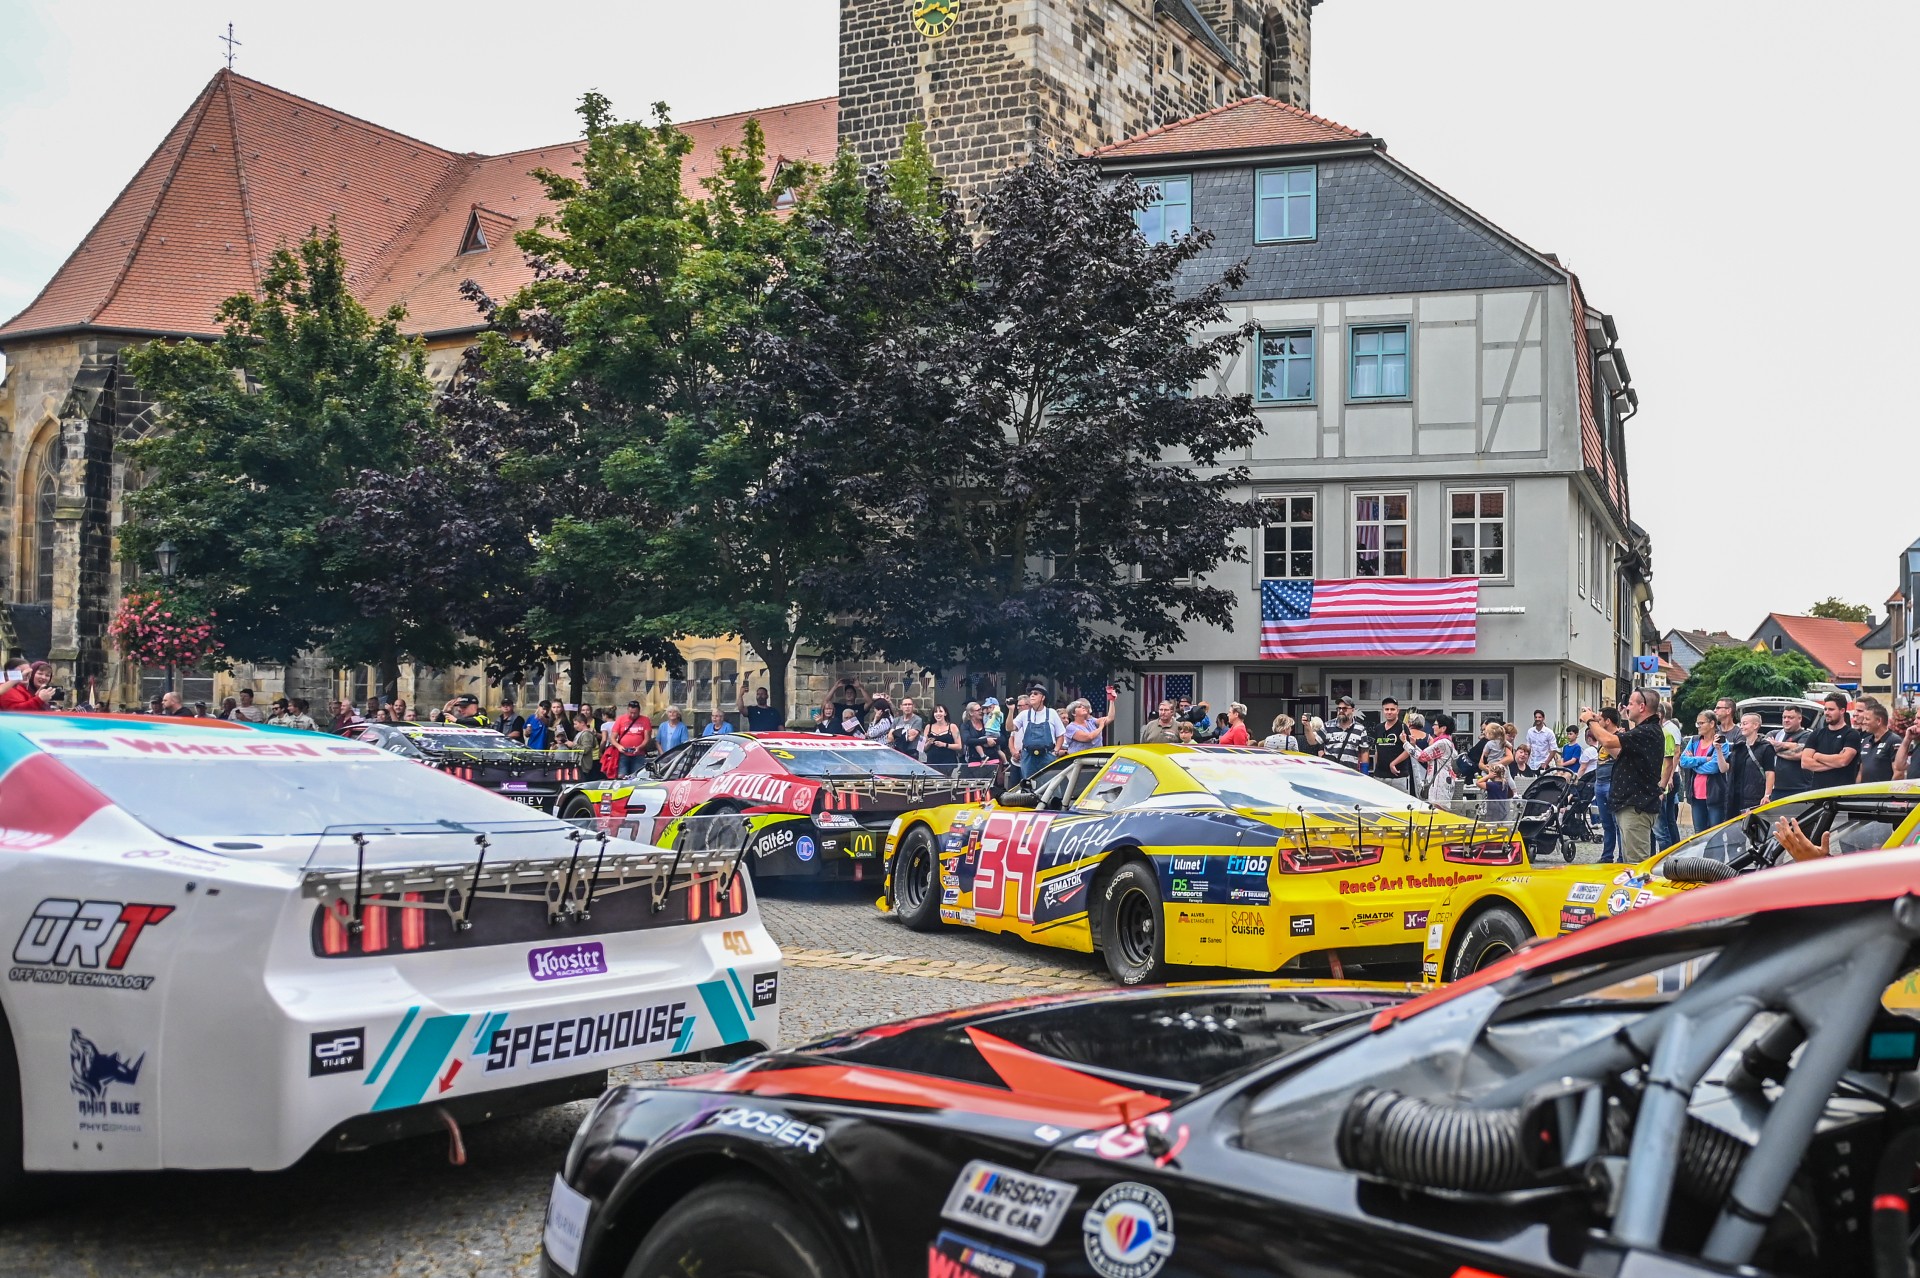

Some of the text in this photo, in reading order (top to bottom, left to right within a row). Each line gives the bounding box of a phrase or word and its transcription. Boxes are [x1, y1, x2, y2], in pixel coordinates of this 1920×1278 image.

[972, 811, 1058, 924] 34
[1227, 855, 1268, 875] Frijob
[1048, 873, 1082, 894] SIMATOK
[1339, 880, 1376, 895] Race
[1379, 877, 1404, 891] Art
[1571, 892, 1596, 901] RACE CAR
[1231, 910, 1265, 927] SARINA
[1356, 911, 1394, 921] SIMATOK
[1560, 910, 1595, 925] WHELEN
[1231, 925, 1265, 936] cuisine
[723, 930, 753, 956] 40
[534, 945, 600, 977] Hoosier
[9, 966, 155, 991] OFF ROAD TECHNOLOGY
[485, 1002, 687, 1073] SPEEDHOUSE
[110, 1101, 141, 1115] BLUE
[707, 1107, 826, 1154] HOOSIER
[989, 1174, 1057, 1210] NASCAR
[960, 1195, 1043, 1234] RACE CAR
